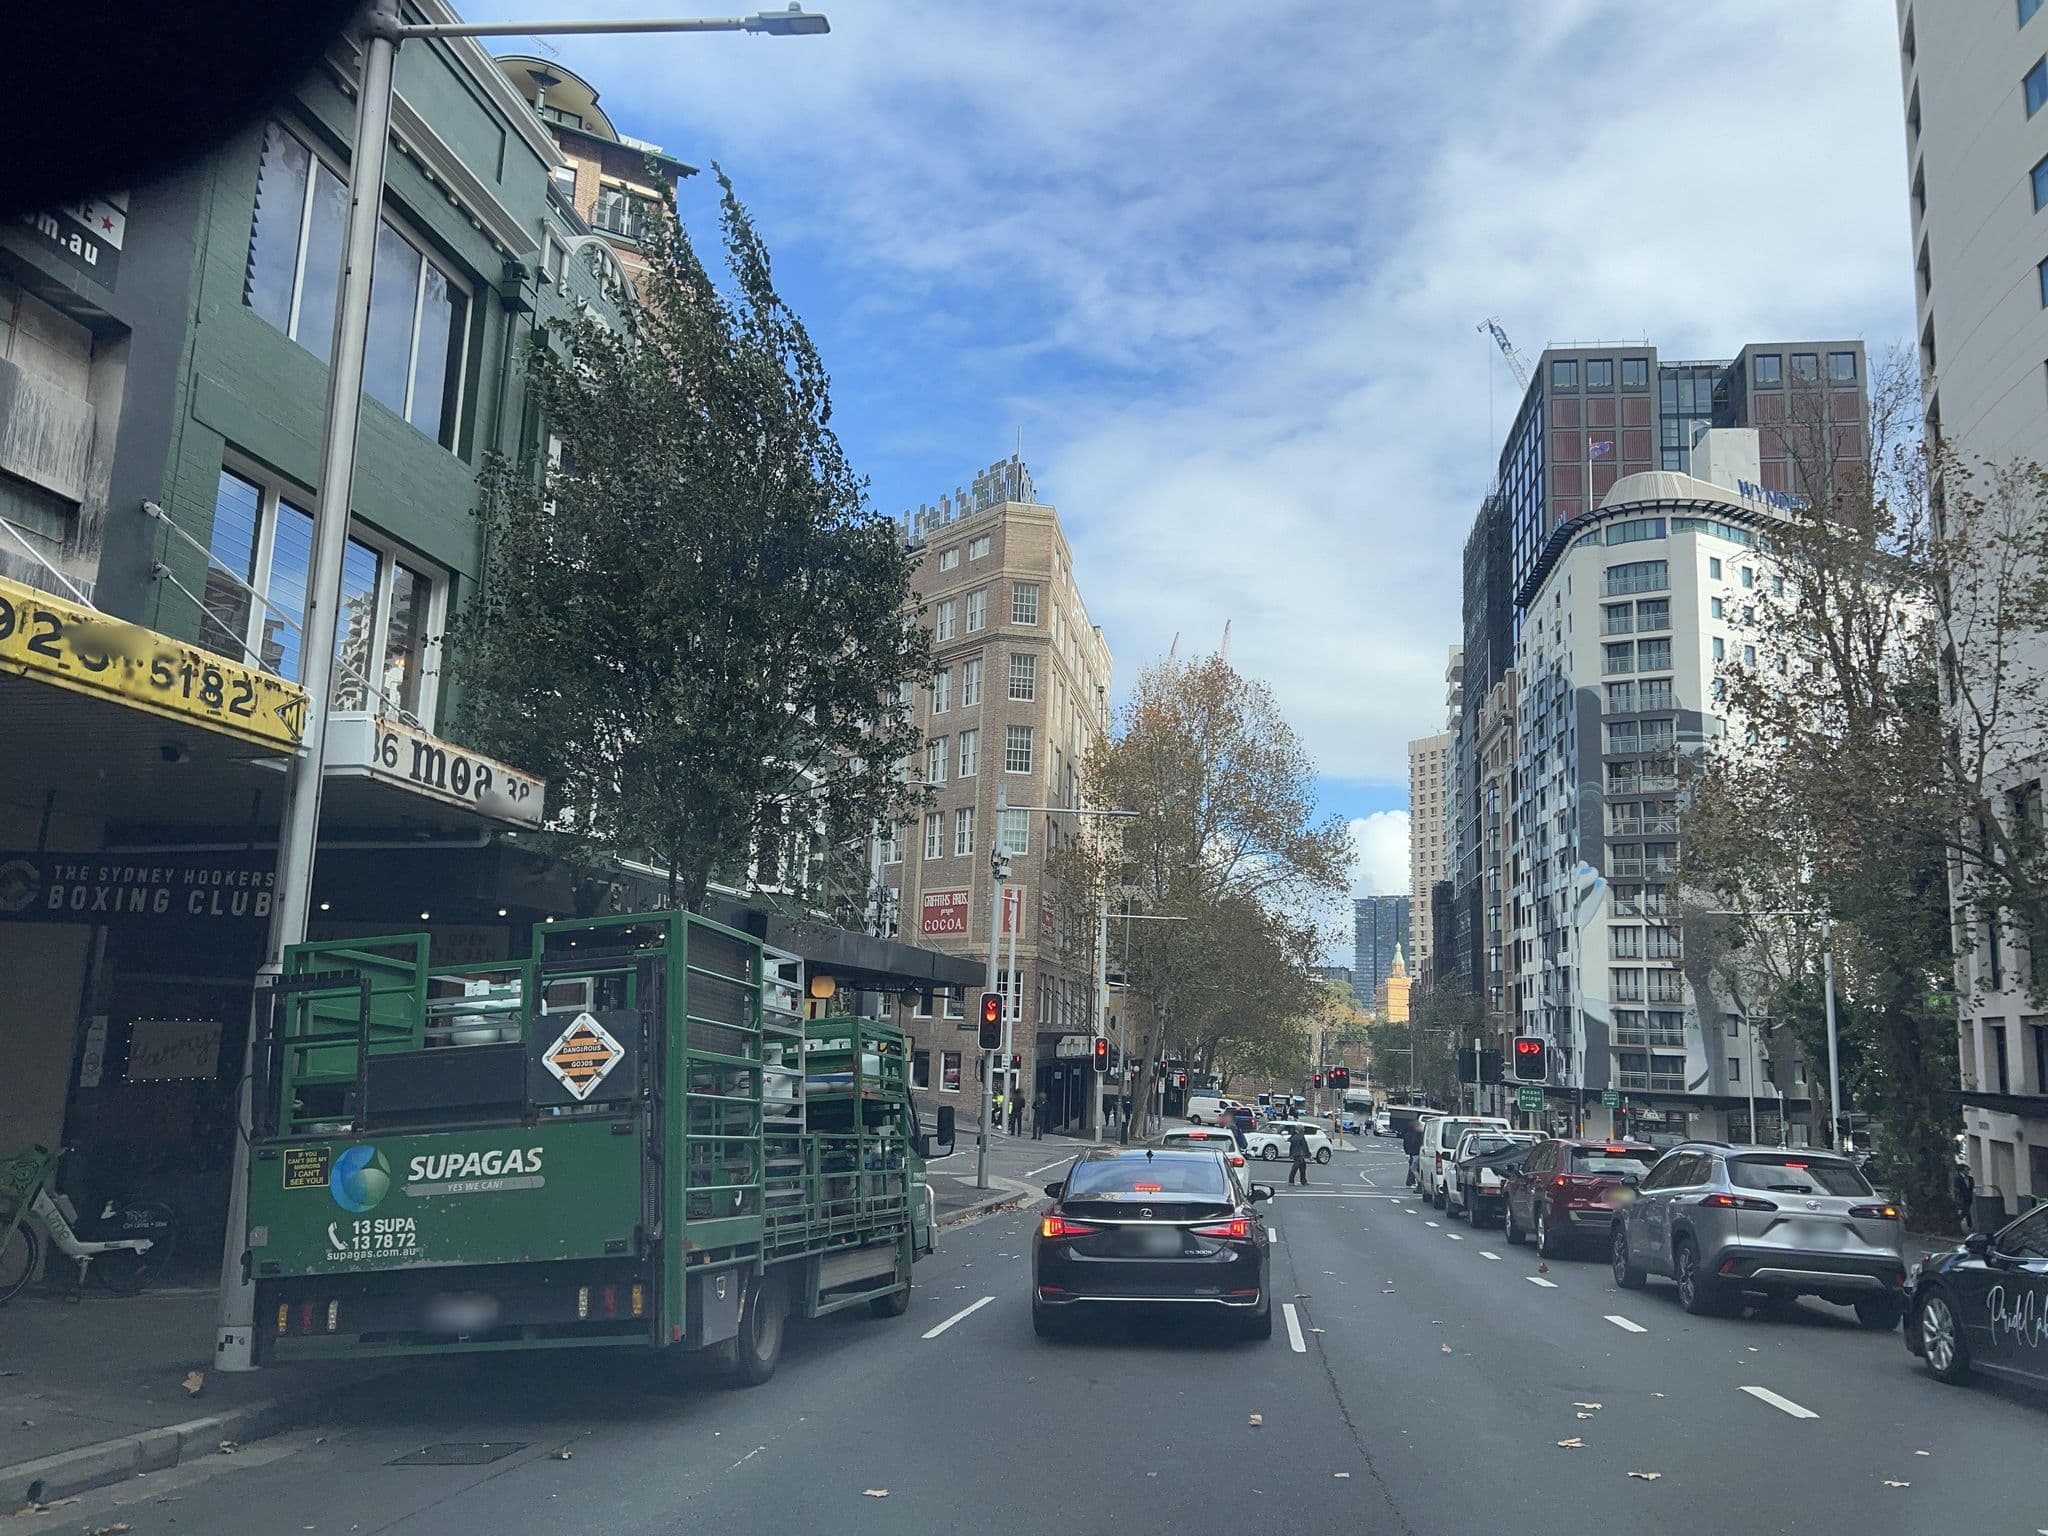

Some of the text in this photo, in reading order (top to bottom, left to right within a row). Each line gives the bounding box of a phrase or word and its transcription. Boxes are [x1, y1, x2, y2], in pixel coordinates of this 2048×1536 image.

[409, 738, 493, 802] moa
[55, 865, 275, 888] THE SYDNEY HOOKERS
[48, 884, 273, 918] BOXING CLUB
[298, 1169, 321, 1177] CAN'T
[408, 1147, 544, 1182] SUPAGAS
[290, 1178, 305, 1186] SEE
[448, 1180, 504, 1193] YES WE CAN!
[352, 1217, 417, 1235] 13 SUPA
[352, 1232, 416, 1250] 13 78 72
[326, 1247, 416, 1262] supagas.com.au
